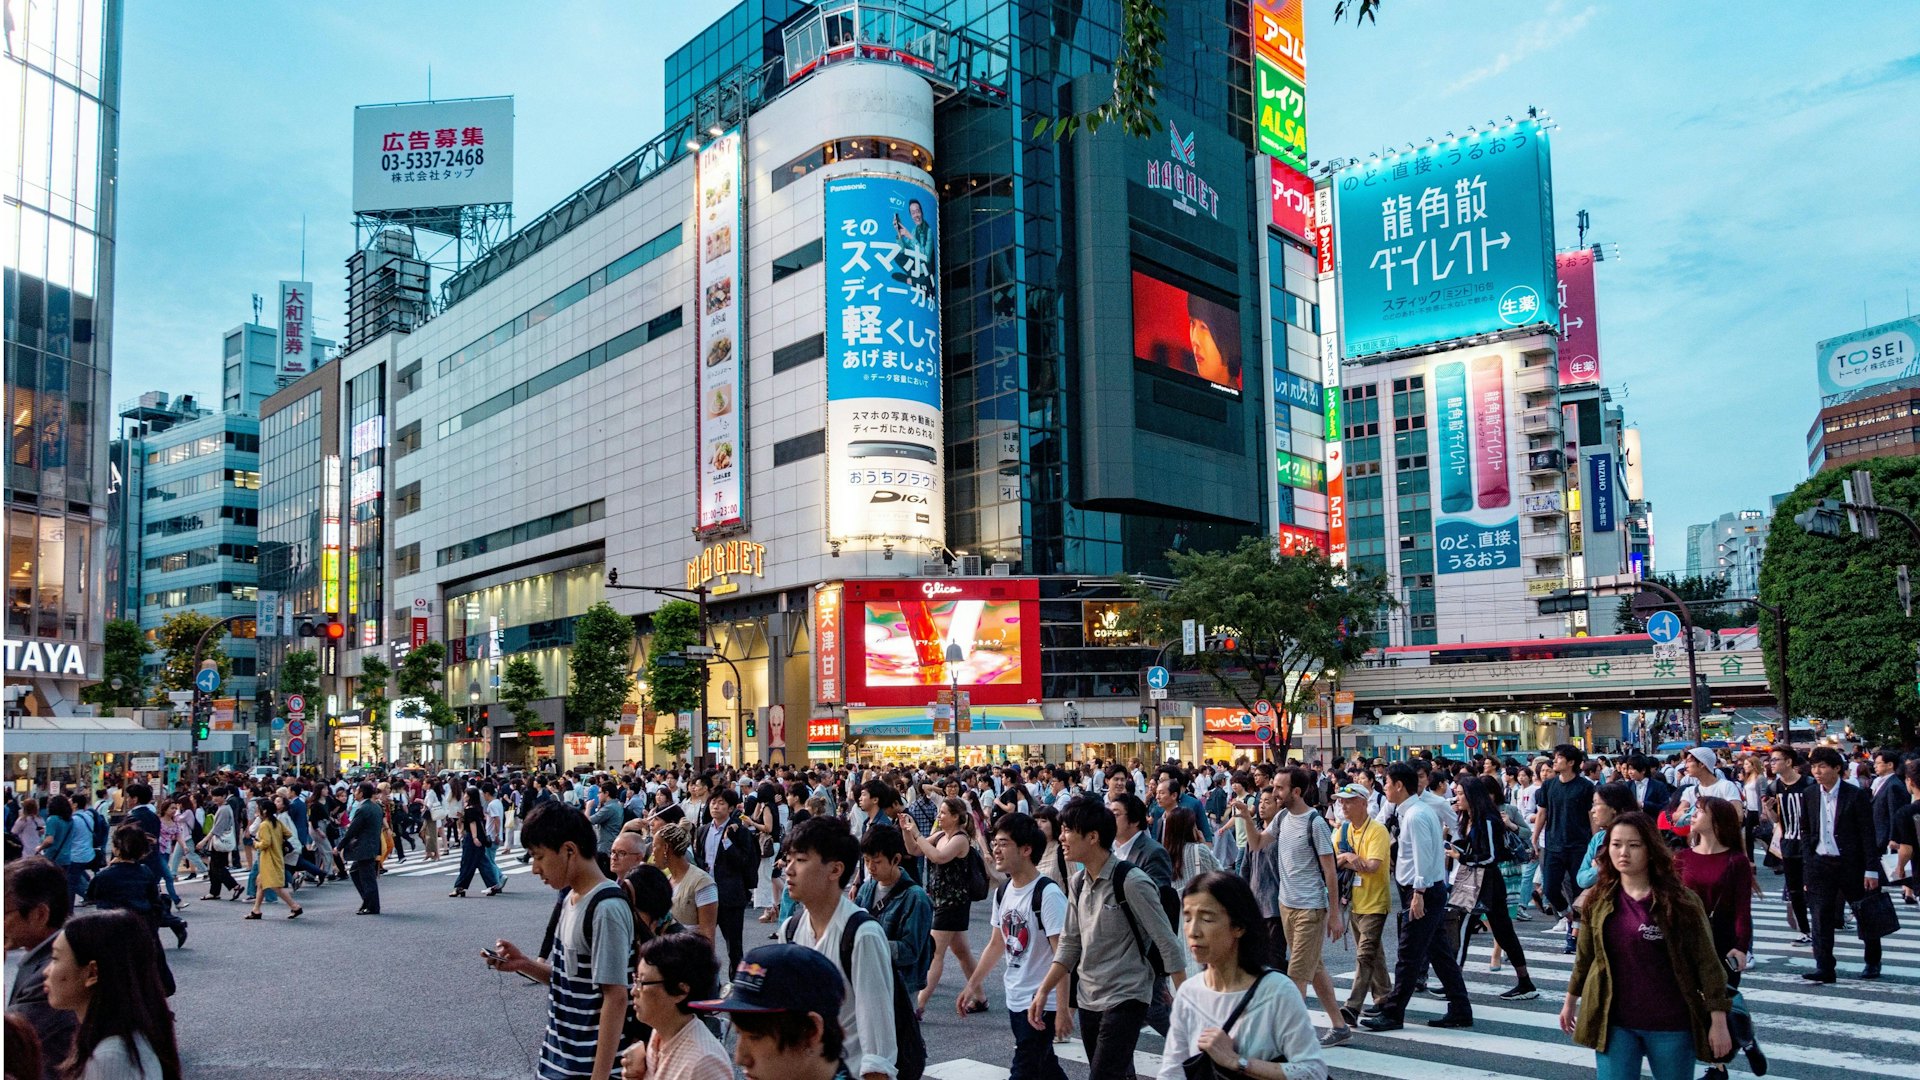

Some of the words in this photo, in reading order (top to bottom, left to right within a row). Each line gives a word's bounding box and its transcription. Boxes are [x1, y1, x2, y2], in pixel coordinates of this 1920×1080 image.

[1263, 15, 1306, 67] アコム
[1260, 69, 1304, 118] レイク
[382, 127, 484, 151] 広告募集
[1260, 104, 1306, 152] ALSA
[381, 148, 484, 171] 03-5337-2468
[1343, 132, 1528, 192] のど、直接、うるおう
[830, 183, 867, 192] Panasonic
[1147, 160, 1219, 220] MAGNET
[1272, 178, 1315, 218] アイフル
[1381, 174, 1489, 242] 龍角散
[841, 219, 878, 237] その
[1321, 237, 1332, 272] アイフル
[1368, 228, 1512, 291] ダイレクト
[841, 276, 936, 312] ディーガが
[1382, 290, 1441, 312] スティック
[1501, 294, 1537, 316] 生薬
[285, 288, 304, 355] 大和証券
[842, 305, 937, 355] 軽くして
[843, 348, 938, 378] あげましょう!
[1837, 340, 1903, 368] TOSEI
[852, 411, 935, 428] スマホの写真や動画は
[849, 470, 938, 489] おうちクラウド
[870, 490, 928, 504] DIGA
[1331, 495, 1343, 529] アコム
[1440, 528, 1518, 551] のど、直接、
[687, 540, 765, 589] MAGNET
[1449, 550, 1507, 570] うるおう
[922, 582, 963, 599] Glico
[4, 639, 85, 675] TAYA
[821, 608, 836, 700] 天津甘栗
[1588, 663, 1611, 675] JR
